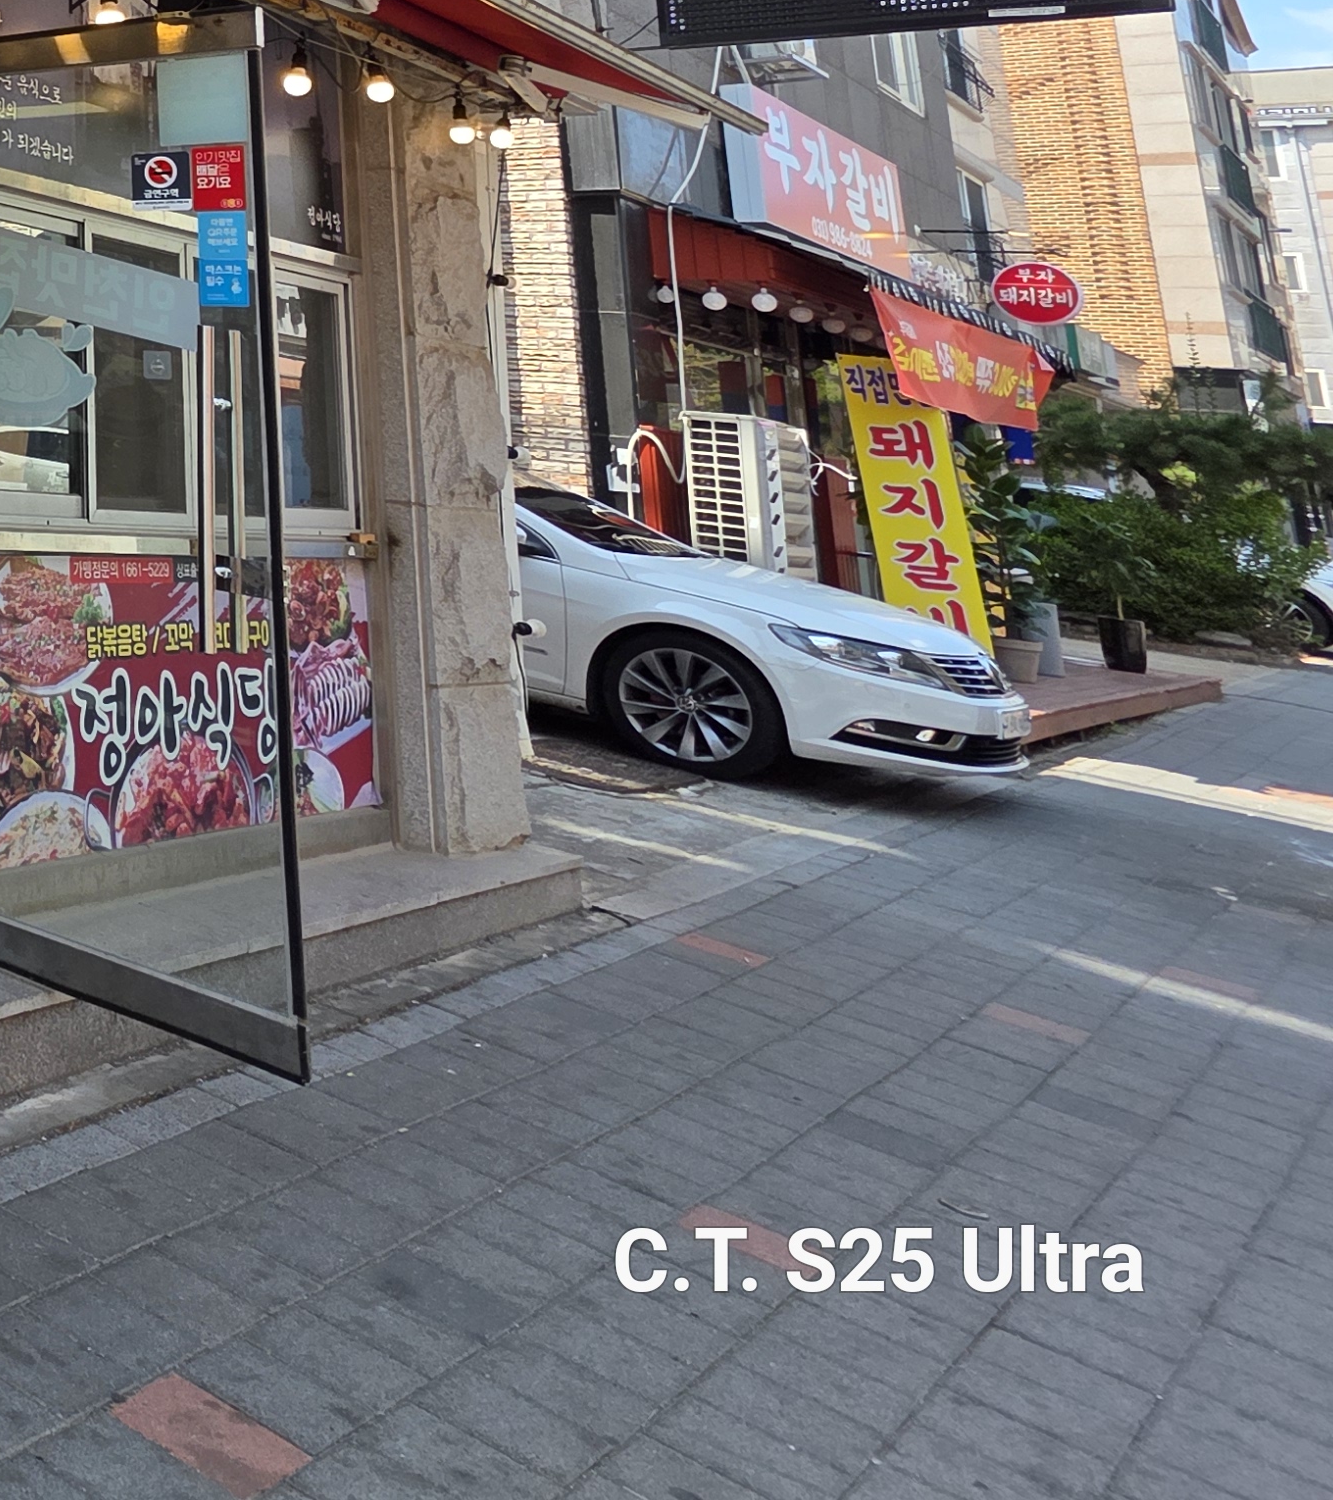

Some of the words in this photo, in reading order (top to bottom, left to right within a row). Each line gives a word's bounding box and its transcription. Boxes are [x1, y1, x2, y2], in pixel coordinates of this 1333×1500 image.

[16, 133, 75, 166] 되겠습니다
[195, 150, 241, 164] 인기맛집
[196, 176, 232, 189] 요기요
[764, 105, 900, 244] 부자갈비
[143, 188, 180, 199] 금연구역
[1015, 268, 1056, 284] 부자
[999, 287, 1074, 308] 돼지갈비
[73, 560, 119, 580] 가맹점문의
[120, 560, 171, 580] 1661-5229
[175, 563, 199, 580] 상표출
[85, 624, 149, 660] 닭볶음탕
[164, 623, 195, 653] 꼬막
[73, 661, 278, 787] 정아식당
